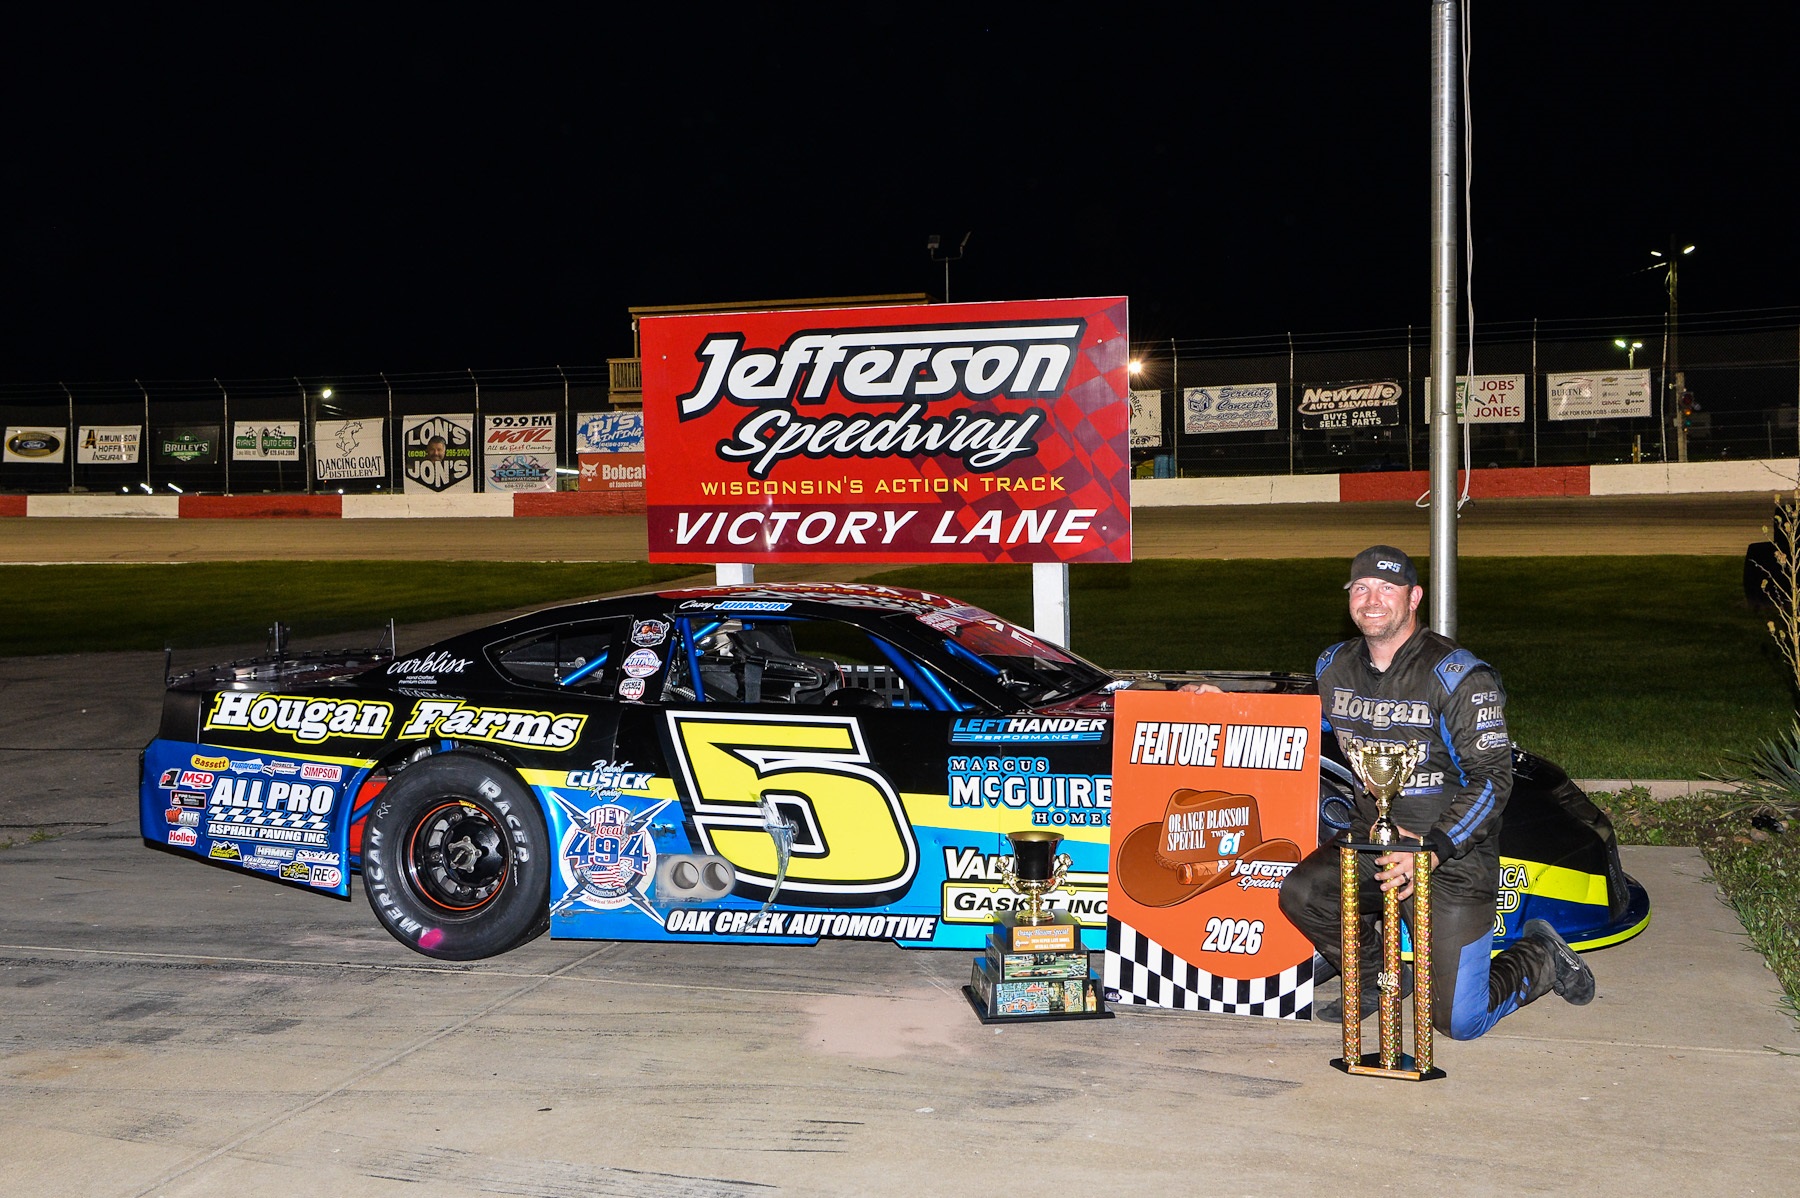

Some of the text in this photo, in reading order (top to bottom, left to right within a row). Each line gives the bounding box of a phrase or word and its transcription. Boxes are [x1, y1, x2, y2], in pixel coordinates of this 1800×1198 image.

[682, 324, 1081, 414] Jefferson
[1219, 387, 1273, 399] Serenity
[1480, 380, 1514, 391] JOBS
[1302, 385, 1396, 403] Newville
[1488, 394, 1506, 404] AT
[1217, 399, 1273, 411] Concepts
[1309, 402, 1335, 410] AUTO
[1338, 400, 1381, 408] SALVAGE
[1474, 407, 1520, 417] JONES
[493, 416, 552, 427] 99.9 FM
[1319, 418, 1381, 428] SELLS PARTS
[1323, 412, 1347, 420] BUYS
[100, 434, 138, 442] AMUNSON
[408, 418, 467, 446] LON'S
[487, 429, 552, 443] WJVL
[590, 428, 642, 445] PINTING
[721, 403, 1040, 474] Speedway
[164, 443, 208, 452] BRULEY'S
[263, 439, 276, 447] AUTO
[278, 439, 293, 447] CARE
[318, 456, 381, 478] DANCING GOAT
[329, 470, 373, 478] DISTILLERY
[408, 460, 468, 488] JON'S
[495, 468, 546, 477] ROEHL
[701, 475, 1066, 496] WISCONSIN'S ACTION TRACK
[674, 508, 1098, 546] VICTORY LANE
[679, 600, 792, 612] Casey JOHNSON
[1332, 689, 1432, 728] Hougan
[210, 691, 582, 747] Hougan Farms
[952, 718, 1107, 733] LEFTHANDER
[974, 733, 1080, 741] PERFORMANCE
[1130, 722, 1309, 771] FEATURE WINNER
[194, 757, 226, 769] Bassett
[952, 759, 1047, 772] MARCUS
[182, 772, 214, 784] MSD
[303, 767, 338, 779] SIMPSON
[566, 771, 654, 790] CUSICK
[210, 778, 264, 809] ALL
[266, 782, 335, 815] PRO
[590, 784, 623, 803] Racing
[666, 710, 917, 894] 5
[478, 776, 530, 863] RACER
[590, 807, 629, 828] IBEW
[1168, 807, 1249, 834] ORANGE BLOSSOM
[169, 831, 196, 846] Holley
[208, 824, 328, 845] ASPHALT PAVING INC.
[1167, 829, 1206, 852] SPECIAL
[1211, 830, 1229, 838] TWIN
[257, 846, 295, 858] HAMKE
[564, 829, 651, 875] 494
[1218, 832, 1241, 856] 61
[297, 850, 339, 861] Swift
[1231, 859, 1299, 877] Jefferso
[1238, 876, 1282, 891] Speedw
[954, 892, 1060, 912] GASKT
[667, 910, 937, 939] OAK CREEK AUTOMOTIVE
[1201, 917, 1264, 955] 2026
